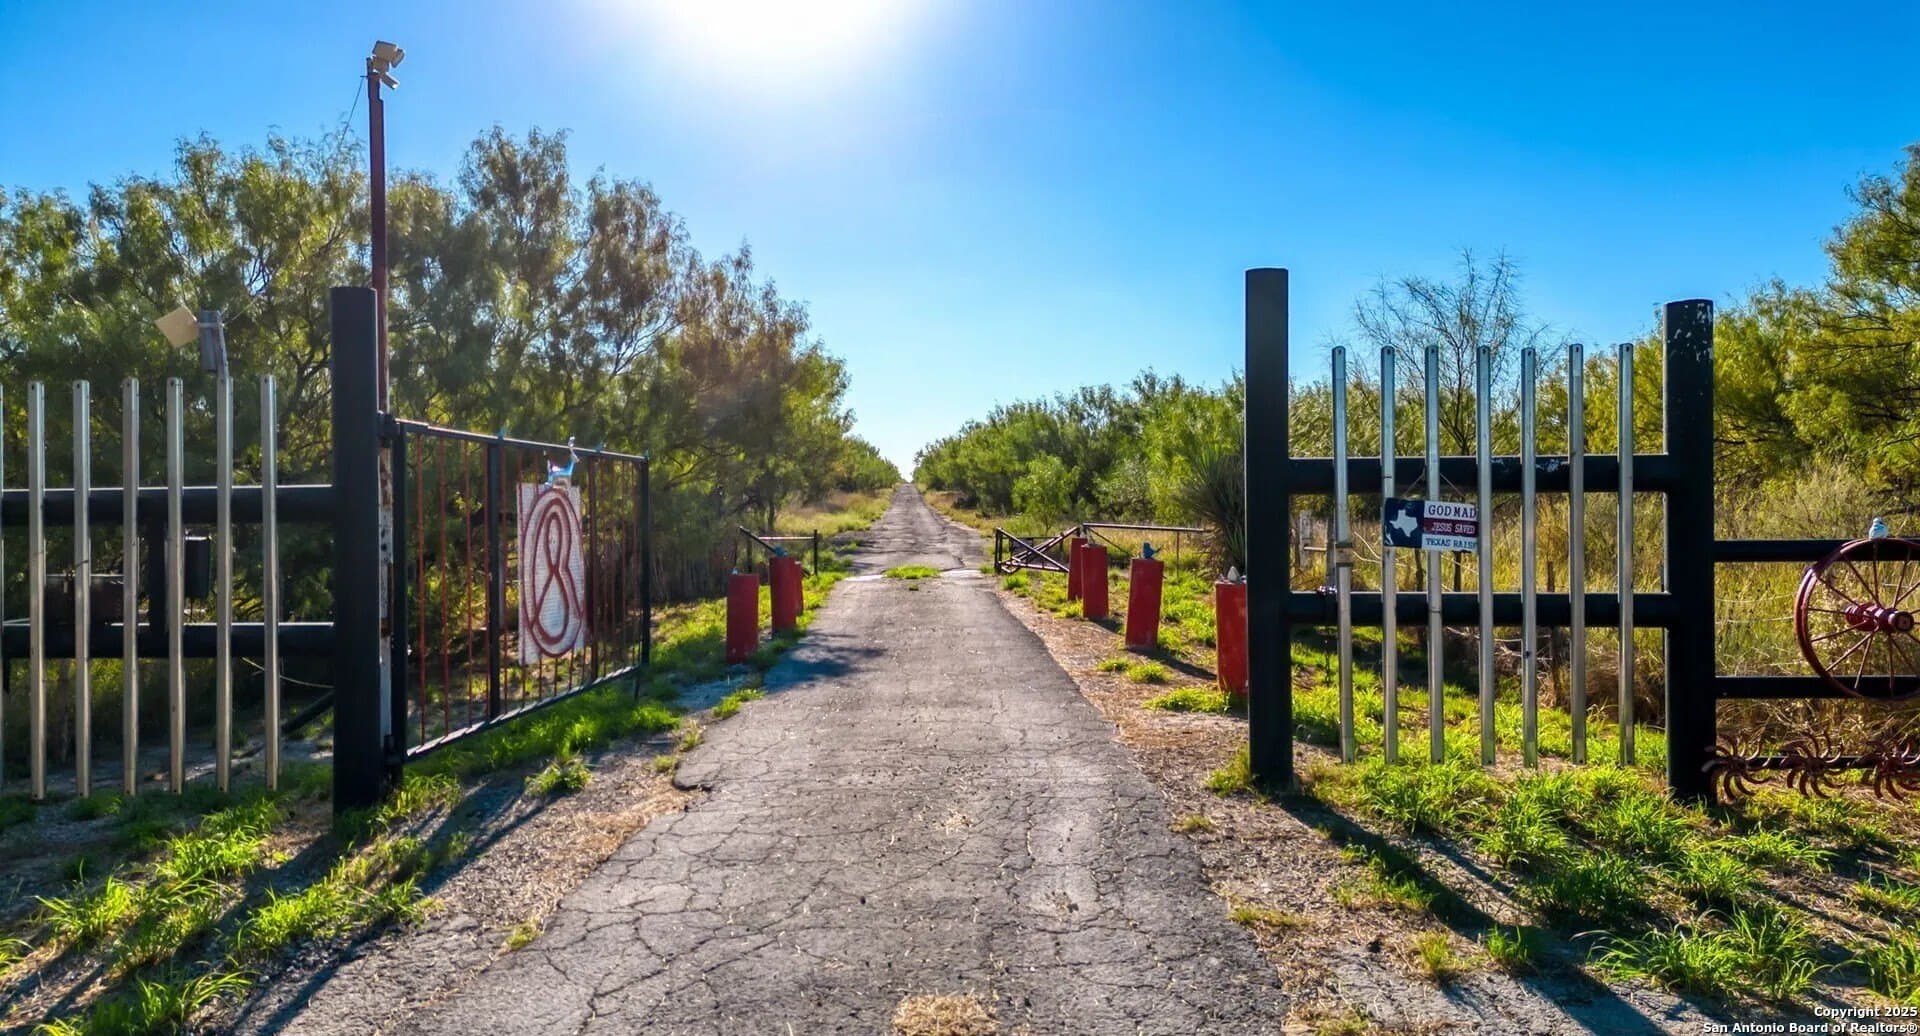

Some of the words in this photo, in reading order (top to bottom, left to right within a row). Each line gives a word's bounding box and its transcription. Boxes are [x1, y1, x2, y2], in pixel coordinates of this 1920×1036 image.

[1428, 504, 1452, 516] GOD
[1453, 506, 1477, 519] MAD
[1431, 521, 1453, 532] JESUS
[1454, 523, 1476, 534] SAVED
[1425, 538, 1451, 547] TEXAS
